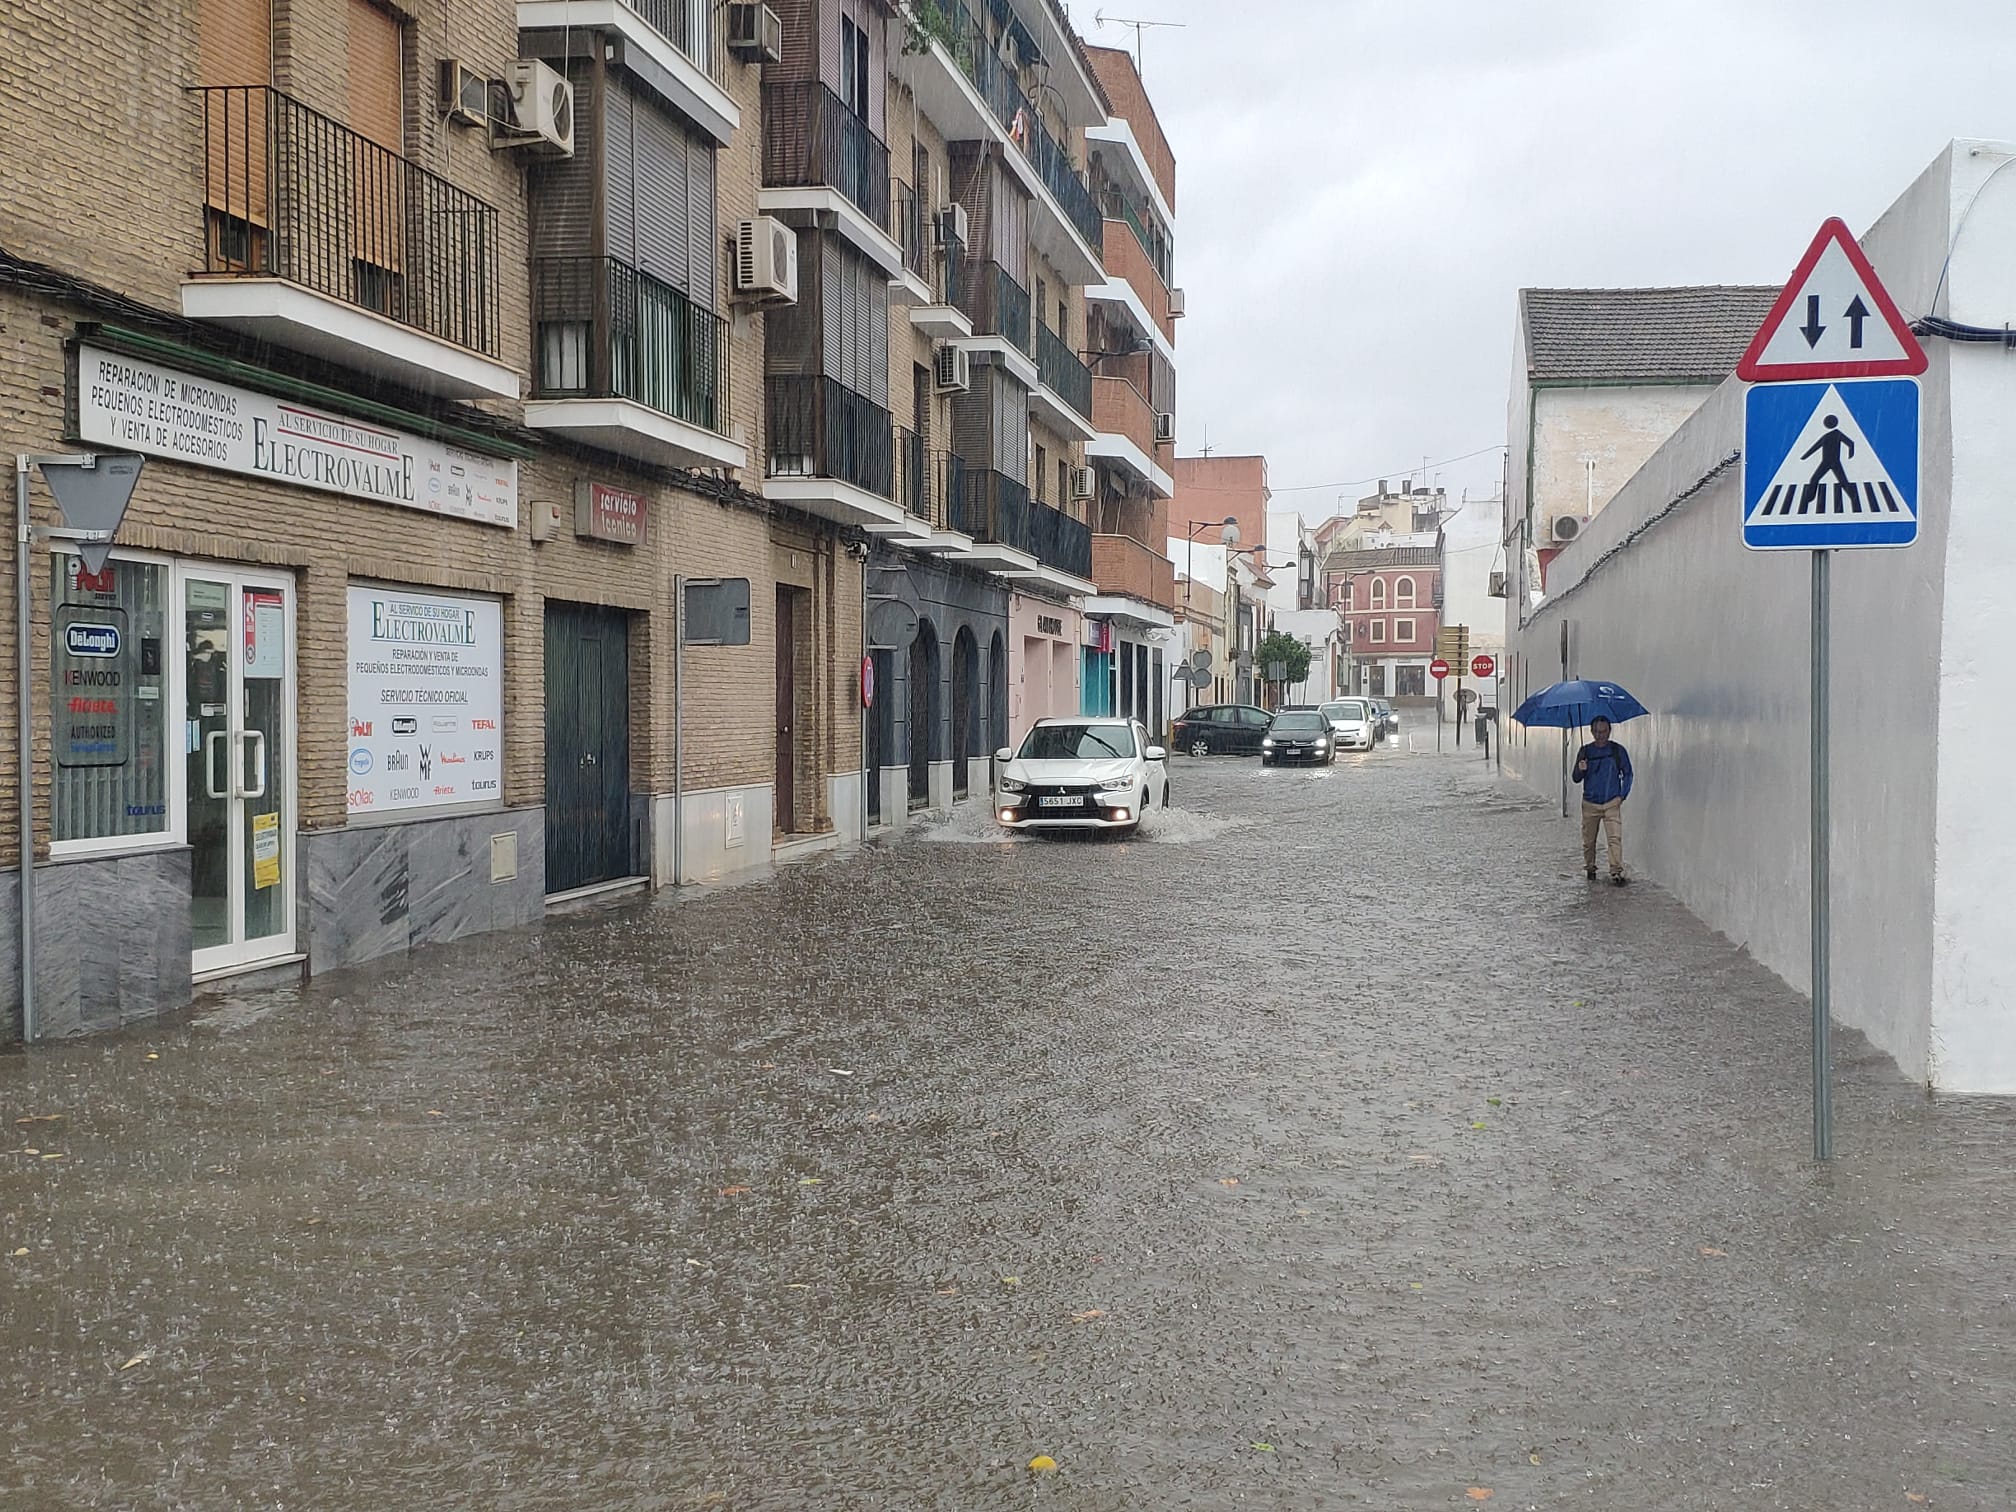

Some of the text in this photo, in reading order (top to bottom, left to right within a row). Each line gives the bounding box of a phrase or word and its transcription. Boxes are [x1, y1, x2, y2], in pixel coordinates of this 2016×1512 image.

[99, 361, 237, 416] REPARACION DE MICROONDAS
[91, 384, 243, 441] PEQUEÑOS ELECTRODOMESTICOS
[110, 415, 228, 461] Y VENTA DE ACCESORIOS
[279, 413, 398, 455] AL SERVICIO DE SU HOGAR
[252, 416, 415, 501] ELECTROVALME
[371, 601, 476, 644] ELECTROVALME
[433, 651, 450, 662] VENTA
[450, 652, 459, 662] DE
[356, 660, 389, 674] PEQUEÑOS
[455, 665, 488, 678] MICROONDAS
[64, 670, 121, 687] KENWOOD
[380, 689, 414, 702] SERVICIO
[444, 691, 468, 703] OFICIAL
[71, 725, 115, 739] AUTHORIZED
[471, 720, 496, 730] TEFAL
[473, 750, 494, 761] KRUPS
[390, 788, 420, 801] KENWOOD
